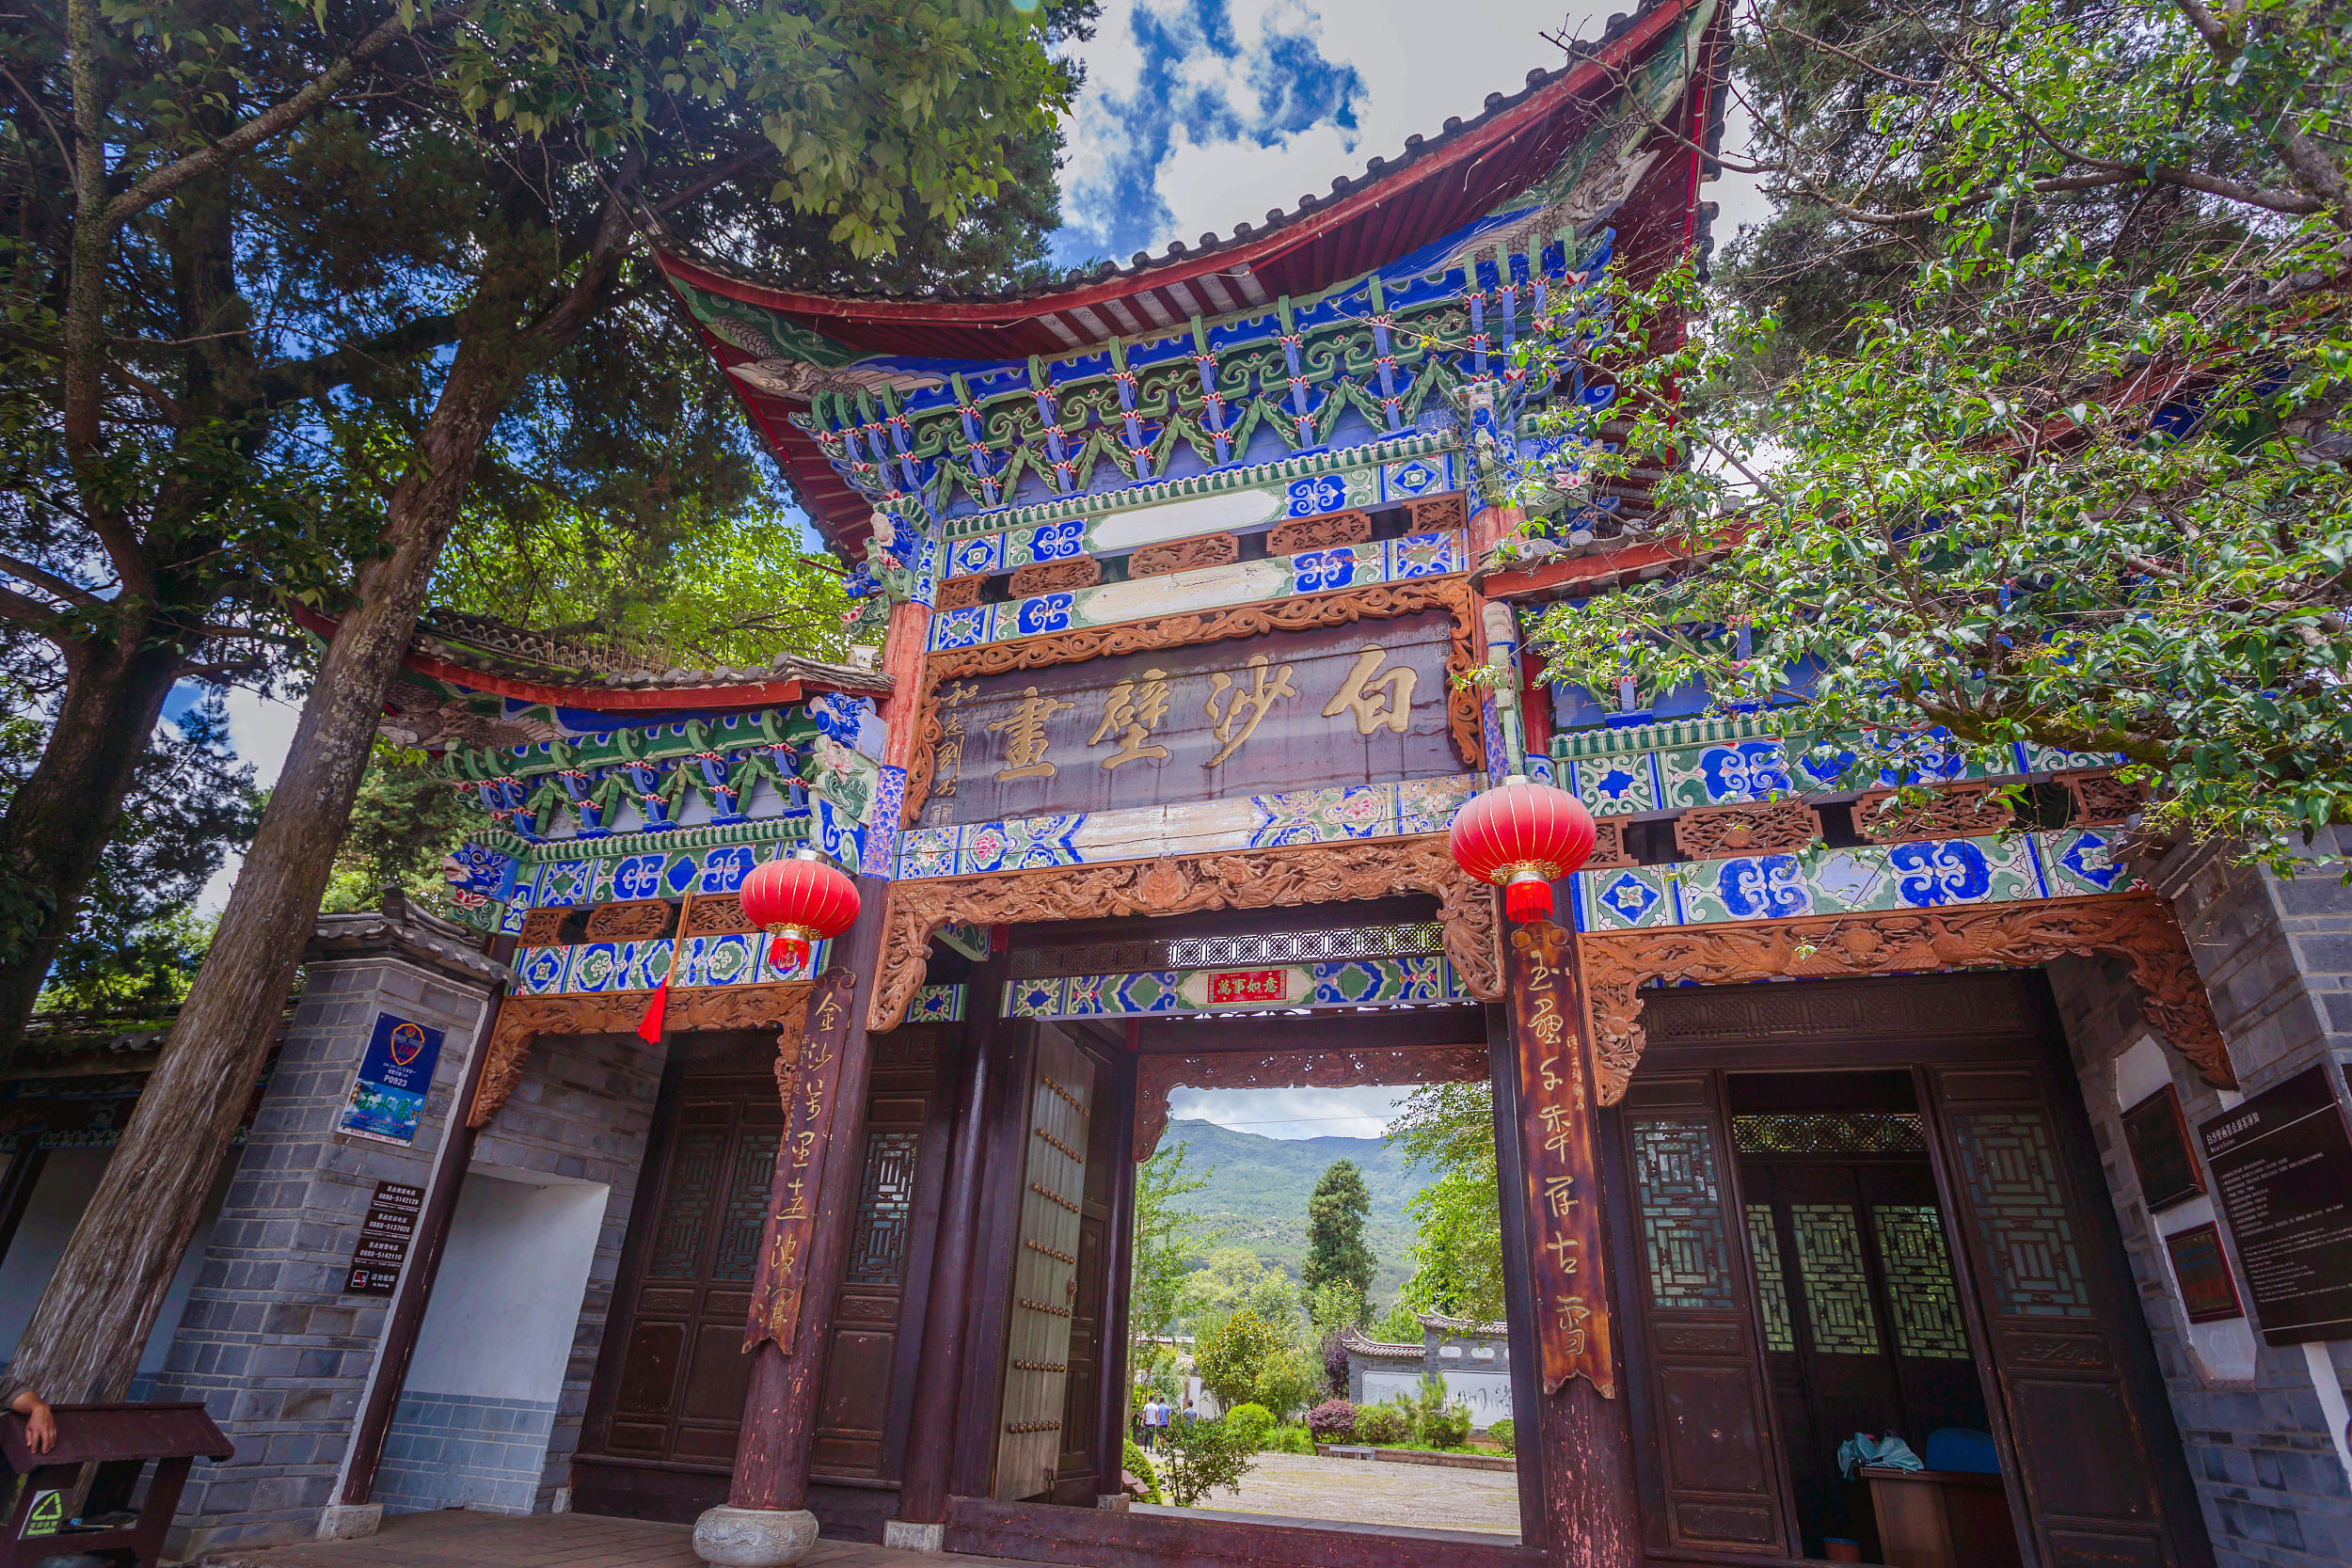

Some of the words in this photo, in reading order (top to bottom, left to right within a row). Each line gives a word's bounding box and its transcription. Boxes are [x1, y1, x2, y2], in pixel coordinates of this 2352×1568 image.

[987, 643, 1418, 782] 白沙壁畫
[1216, 977, 1279, 995] 萬事如意
[383, 1074, 408, 1087] P0923
